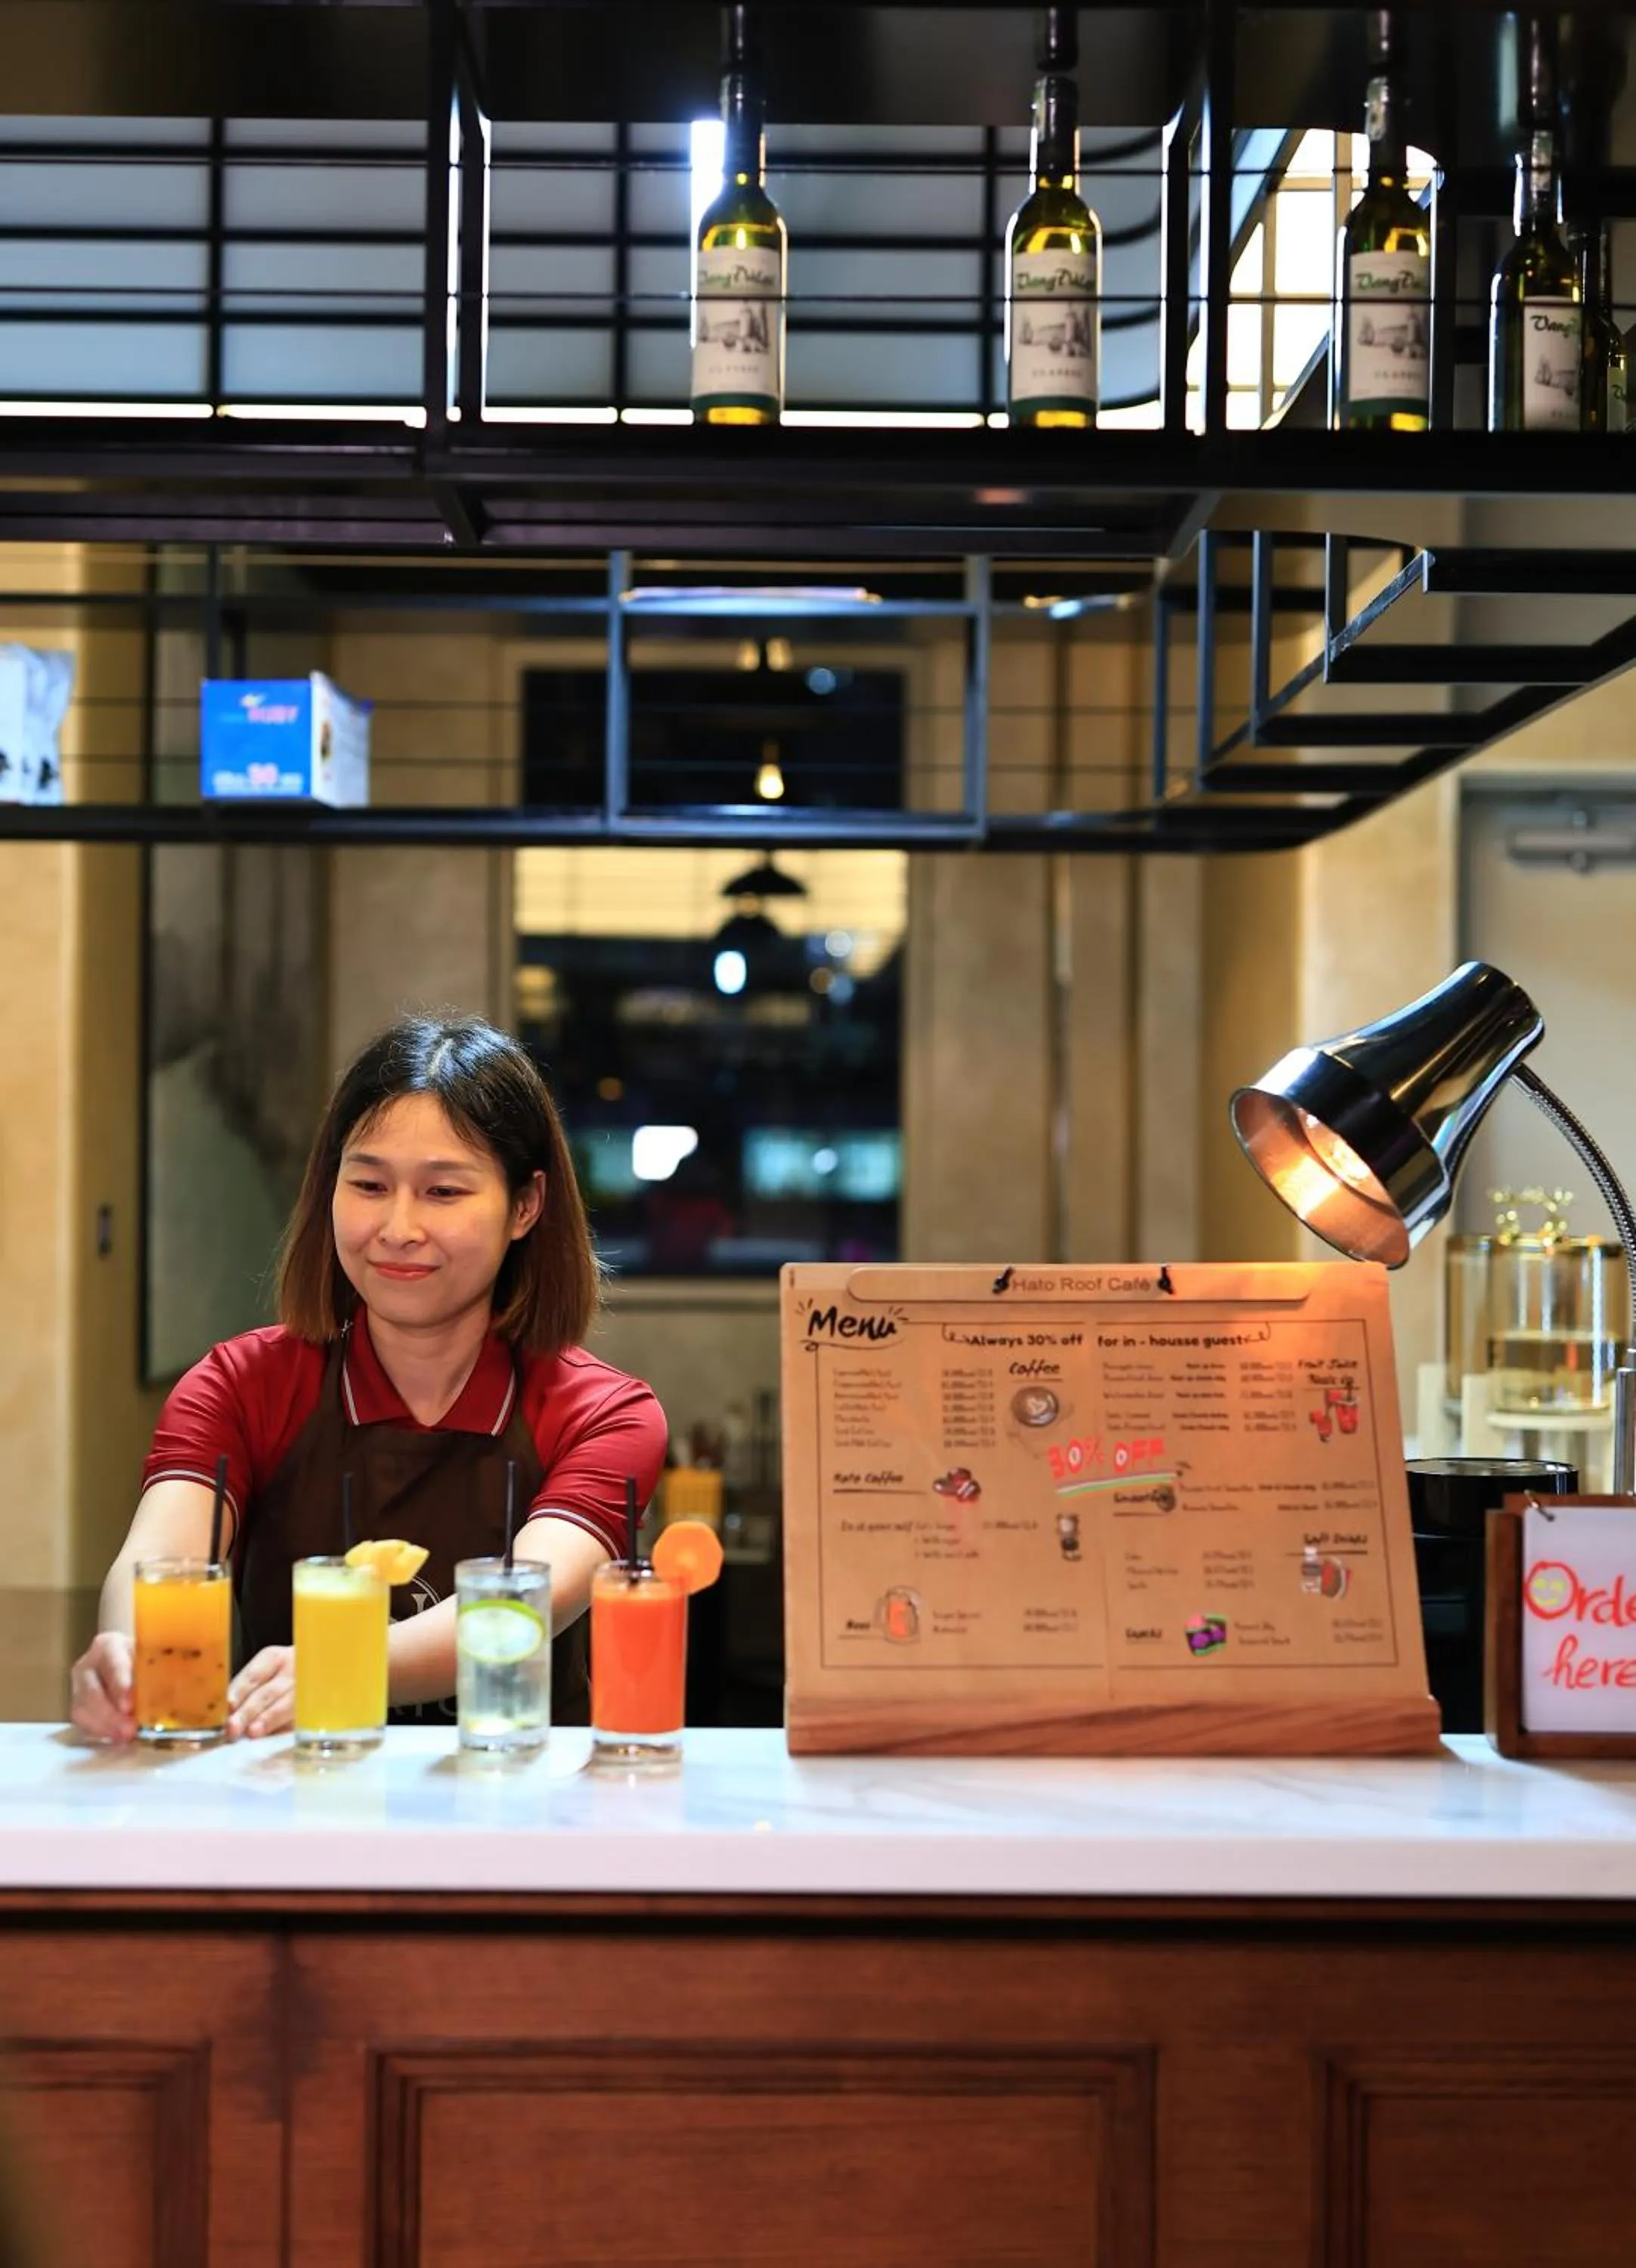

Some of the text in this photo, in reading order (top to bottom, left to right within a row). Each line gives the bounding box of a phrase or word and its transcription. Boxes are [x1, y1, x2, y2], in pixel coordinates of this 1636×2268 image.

[1012, 1276, 1151, 1291] Hato Roof Café
[807, 1306, 897, 1340] Menu
[969, 1334, 1023, 1348] Always
[1027, 1334, 1057, 1346] 30%
[1061, 1334, 1083, 1346] off
[1098, 1335, 1117, 1347] for
[1123, 1335, 1136, 1346] in
[1203, 1335, 1244, 1349] guest
[1009, 1359, 1061, 1377] Coffee
[864, 1470, 904, 1487] Coffee
[1541, 1634, 1636, 1690] here
